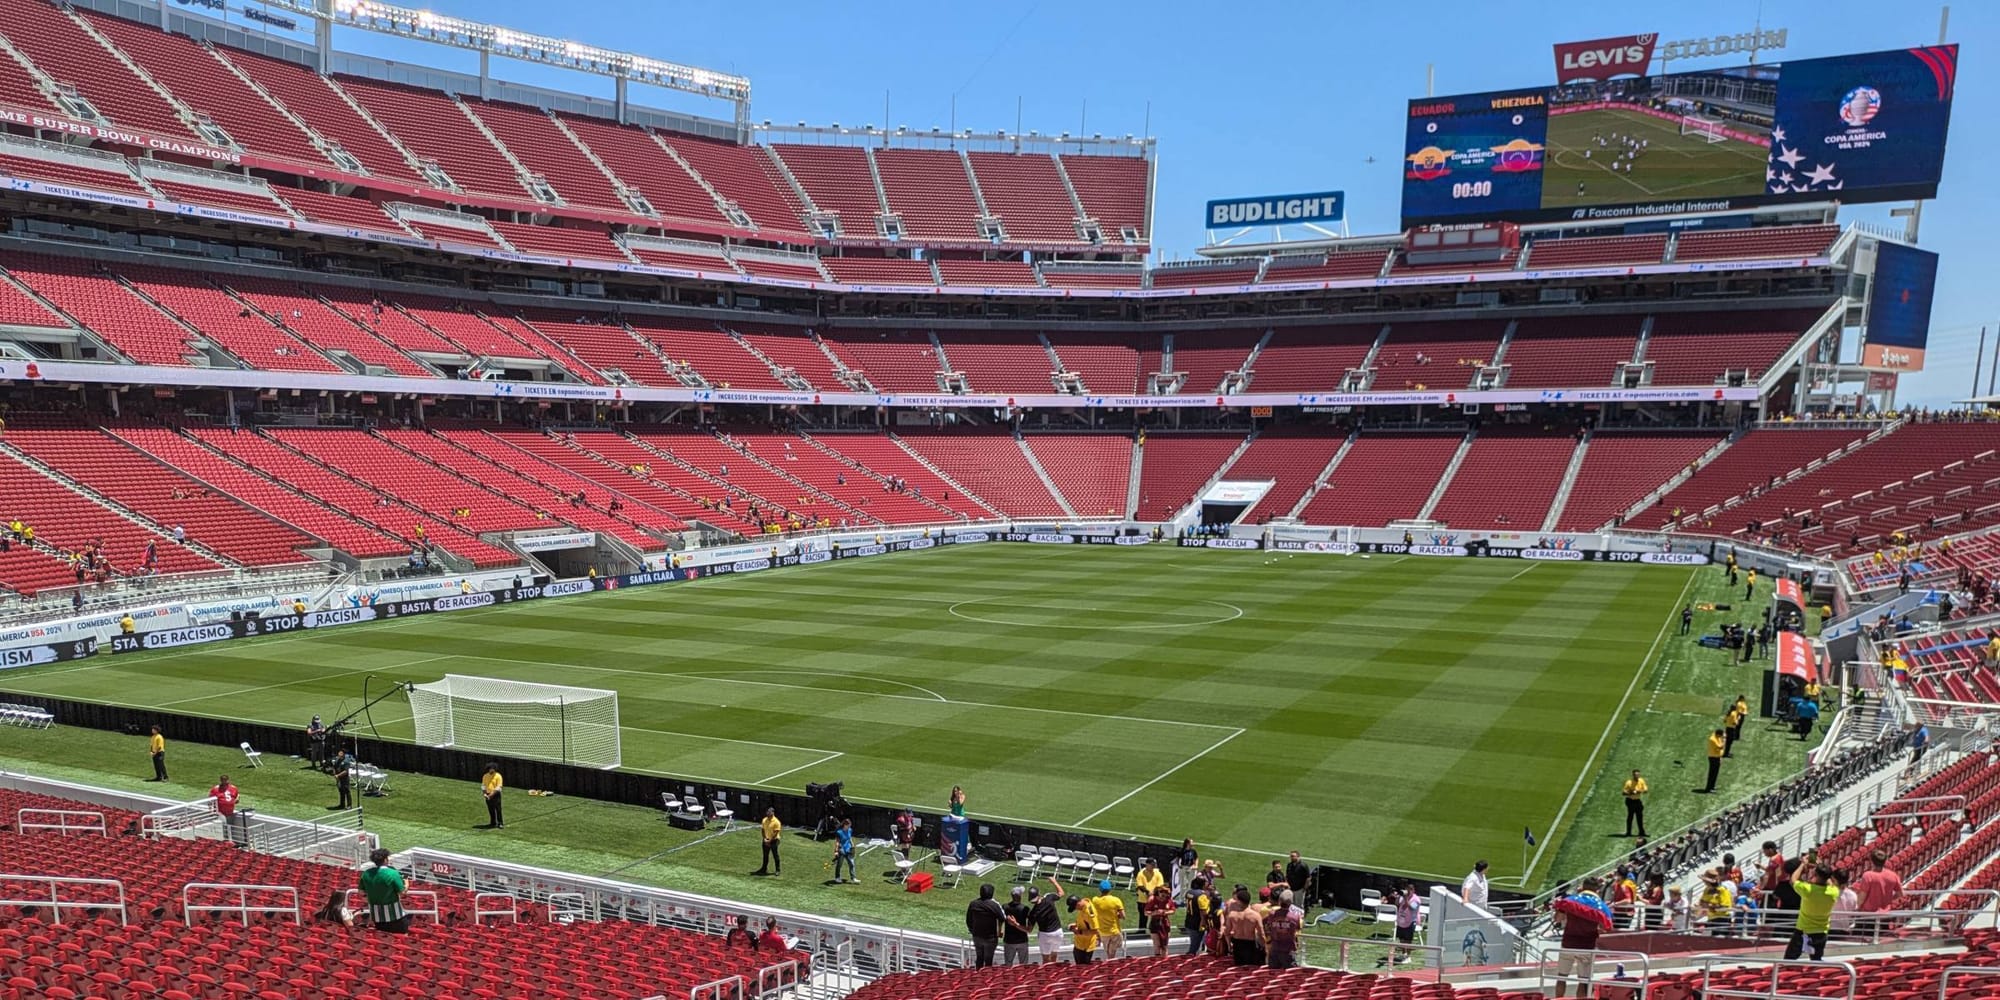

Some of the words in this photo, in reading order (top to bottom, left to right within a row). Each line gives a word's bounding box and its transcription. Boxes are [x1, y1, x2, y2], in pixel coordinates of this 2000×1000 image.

[245, 8, 296, 30] ticketmaster
[1662, 28, 1788, 61] STADIUM
[1491, 96, 1544, 109] VENEZUELA
[1411, 104, 1455, 116] ECUADOR
[32, 116, 92, 136] SUPER
[97, 128, 144, 144] BOWL
[150, 139, 240, 163] CHAMPIONS
[1824, 134, 1848, 144] COPA
[44, 186, 70, 196] TICKETS
[1452, 180, 1492, 199] 00:00
[1213, 203, 1262, 224] BUD
[1264, 197, 1336, 221] LIGHT
[1588, 205, 1633, 218] Foxconn
[1636, 202, 1686, 215] Industrial
[1688, 200, 1730, 212] Internet
[896, 542, 908, 550] STOP
[1182, 538, 1205, 547] STOP
[1216, 539, 1247, 548] RACISM
[784, 555, 798, 565] STOP
[805, 551, 825, 561] RACISM
[1539, 550, 1580, 559] RACISMO
[1609, 552, 1638, 561] STOP
[1652, 554, 1693, 562] RACISM
[714, 563, 732, 574] BASTA
[735, 562, 744, 570] DE
[745, 559, 768, 570] RACISMO
[630, 574, 651, 585] SANTA
[653, 570, 675, 582] CLARA
[404, 584, 418, 592] COPA
[420, 582, 442, 590] AMERICA
[516, 586, 540, 599] STOP
[552, 583, 584, 594] RACISM
[231, 604, 250, 612] COPA
[401, 601, 431, 614] BASTA
[439, 600, 451, 609] DE
[452, 594, 491, 608] RACISMO
[76, 618, 113, 630] CONMEBOL
[157, 608, 169, 616] USA
[170, 606, 183, 615] 2024
[265, 617, 299, 632] STOP
[316, 609, 361, 626] RACISM
[30, 629, 45, 637] USA
[46, 626, 62, 635] 2024
[113, 637, 139, 650] STA
[151, 634, 168, 646] DE
[171, 626, 226, 644] RACISMO
[0, 650, 33, 666] ISM
[224, 790, 232, 801] 5
[433, 863, 449, 874] 102
[726, 915, 738, 926] 10
